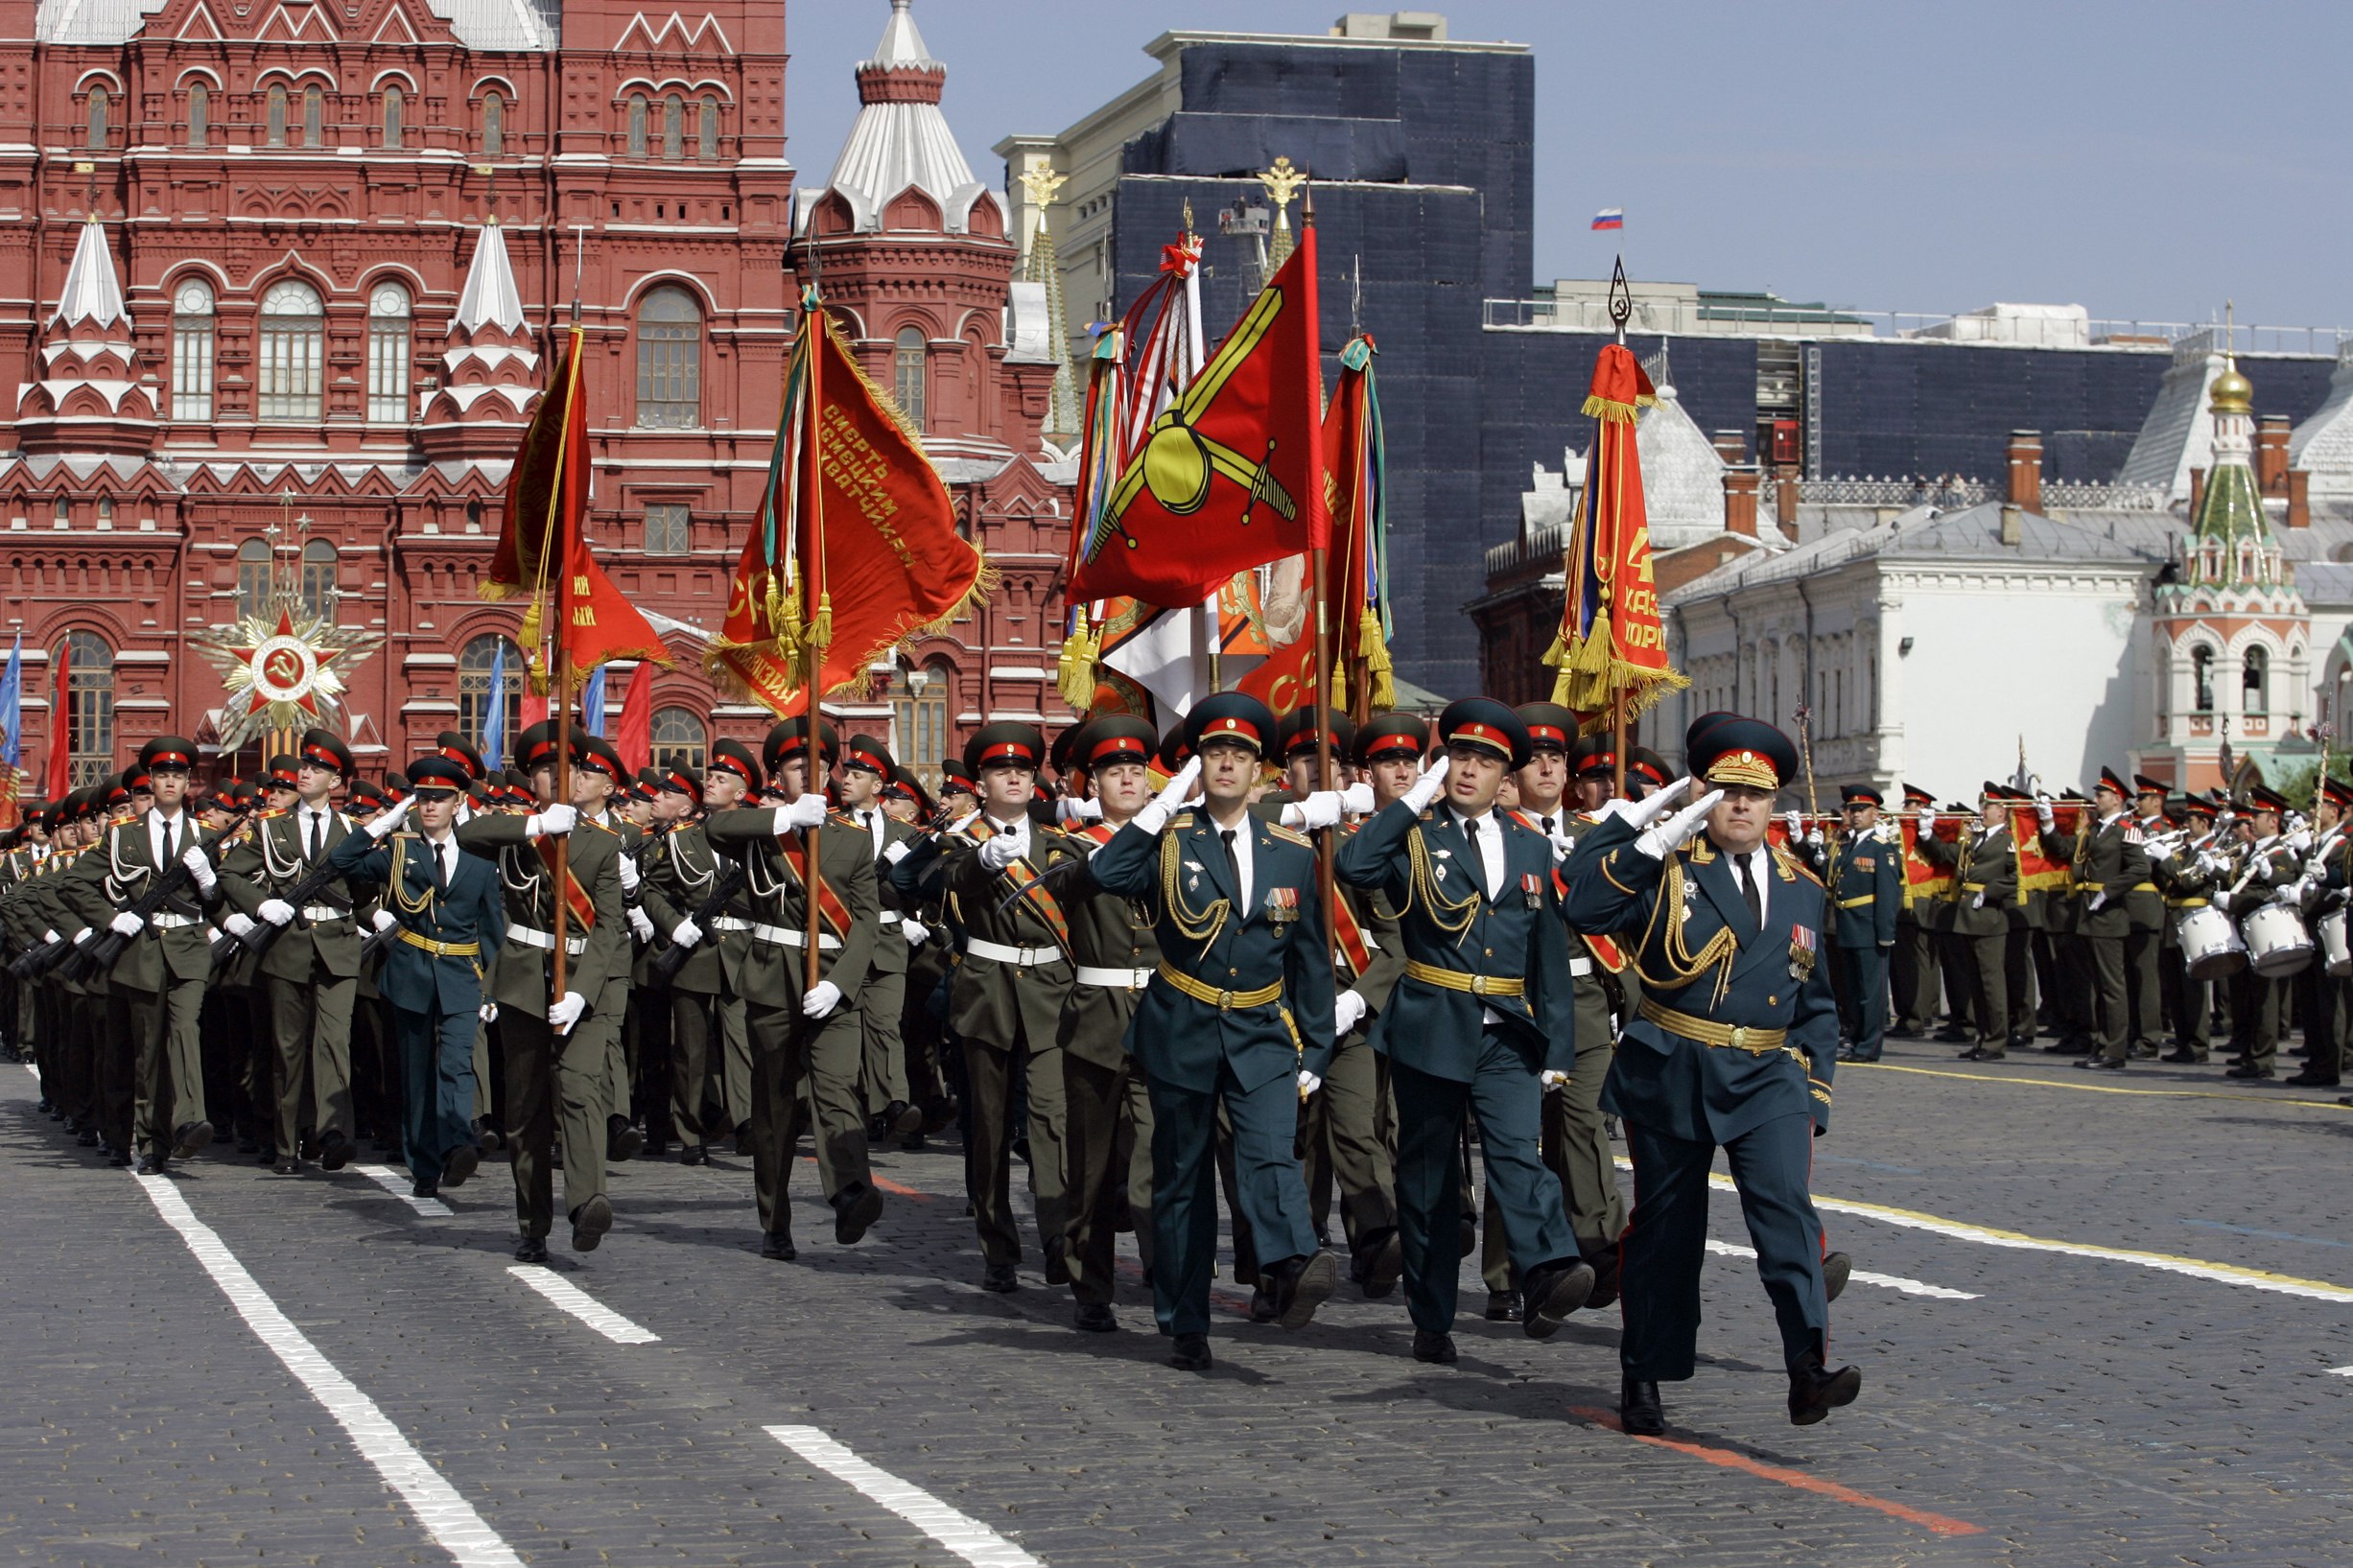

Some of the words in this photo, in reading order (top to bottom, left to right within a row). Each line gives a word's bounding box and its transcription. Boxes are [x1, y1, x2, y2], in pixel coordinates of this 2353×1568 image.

[820, 421, 899, 517] ЕМЕЦКИМ
[823, 404, 889, 480] СМЕРТЬ
[253, 637, 310, 694] ОТЕЧЕСТВЕННАЯ
